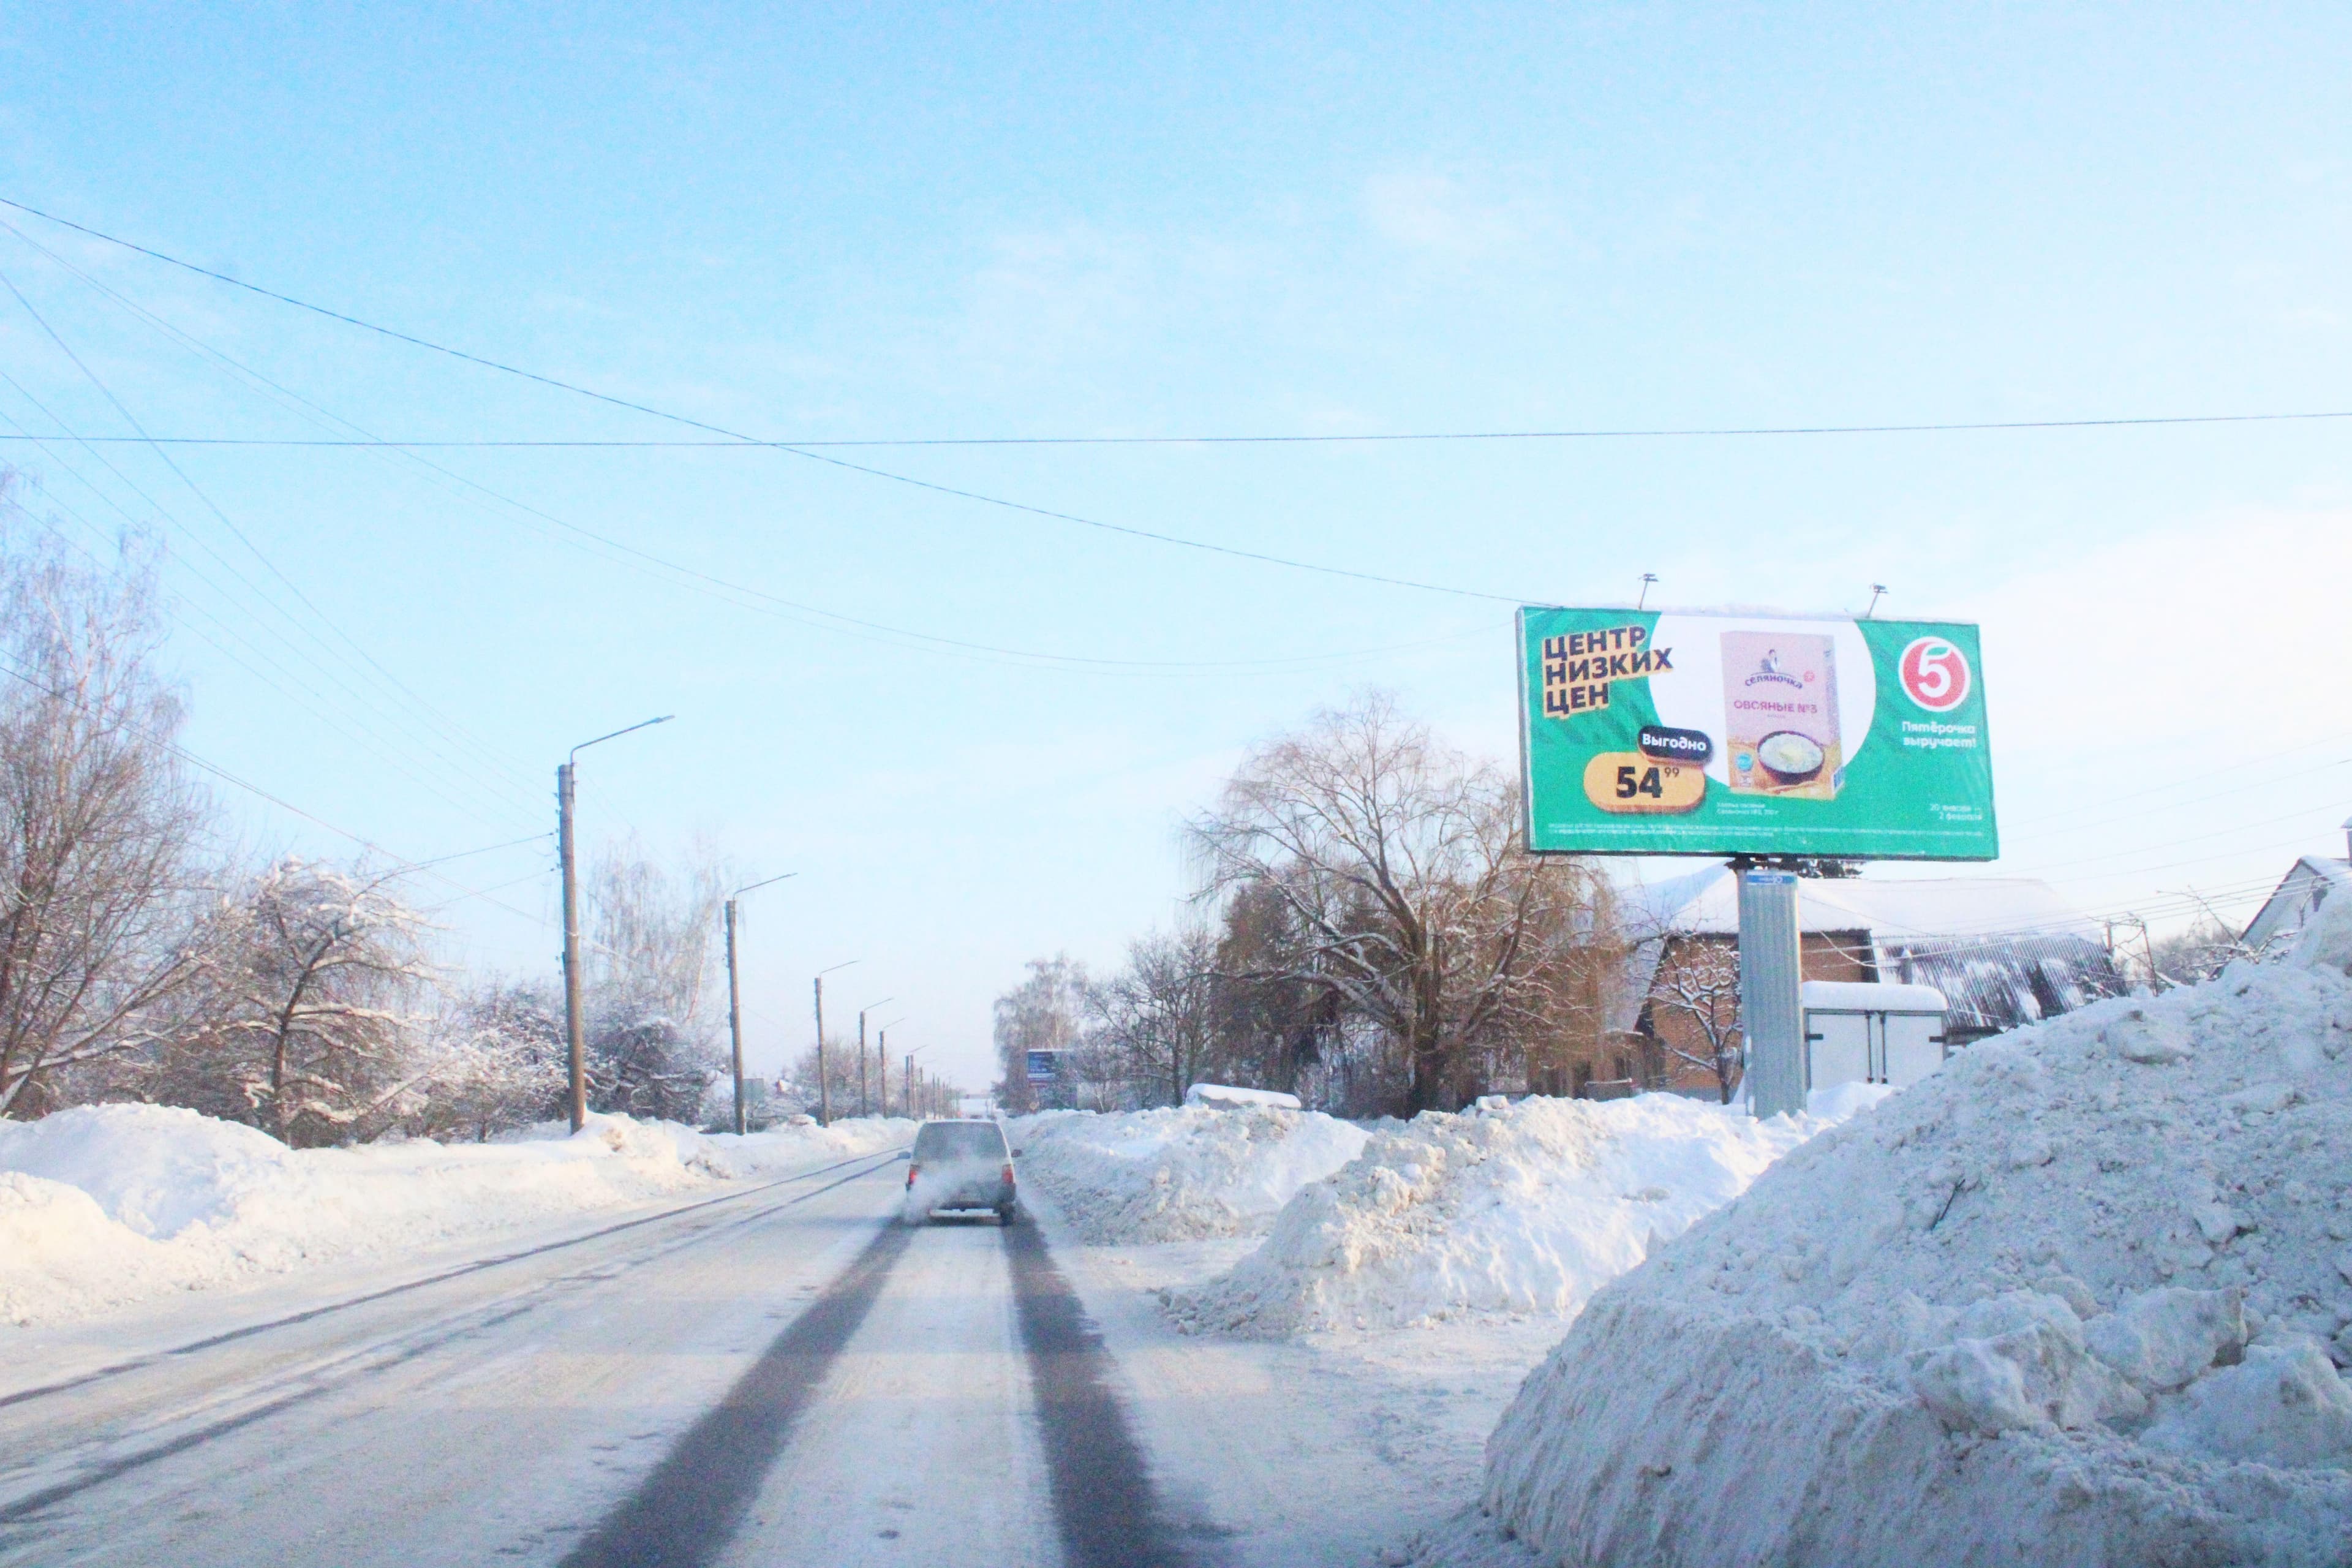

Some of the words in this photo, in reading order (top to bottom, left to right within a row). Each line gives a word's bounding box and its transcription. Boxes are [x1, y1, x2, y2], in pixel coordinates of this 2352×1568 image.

[1545, 626, 1646, 661] ЦЕНТР
[1545, 647, 1673, 686] НИЗКИХ
[1547, 683, 1608, 714] ЦЕН
[1734, 700, 1795, 712] ОВСЯНЫЕ
[1642, 733, 1706, 751] Выгодно
[1902, 720, 1976, 735] Пятёрочка
[1616, 766, 1663, 799] 54
[1664, 767, 1679, 778] 99
